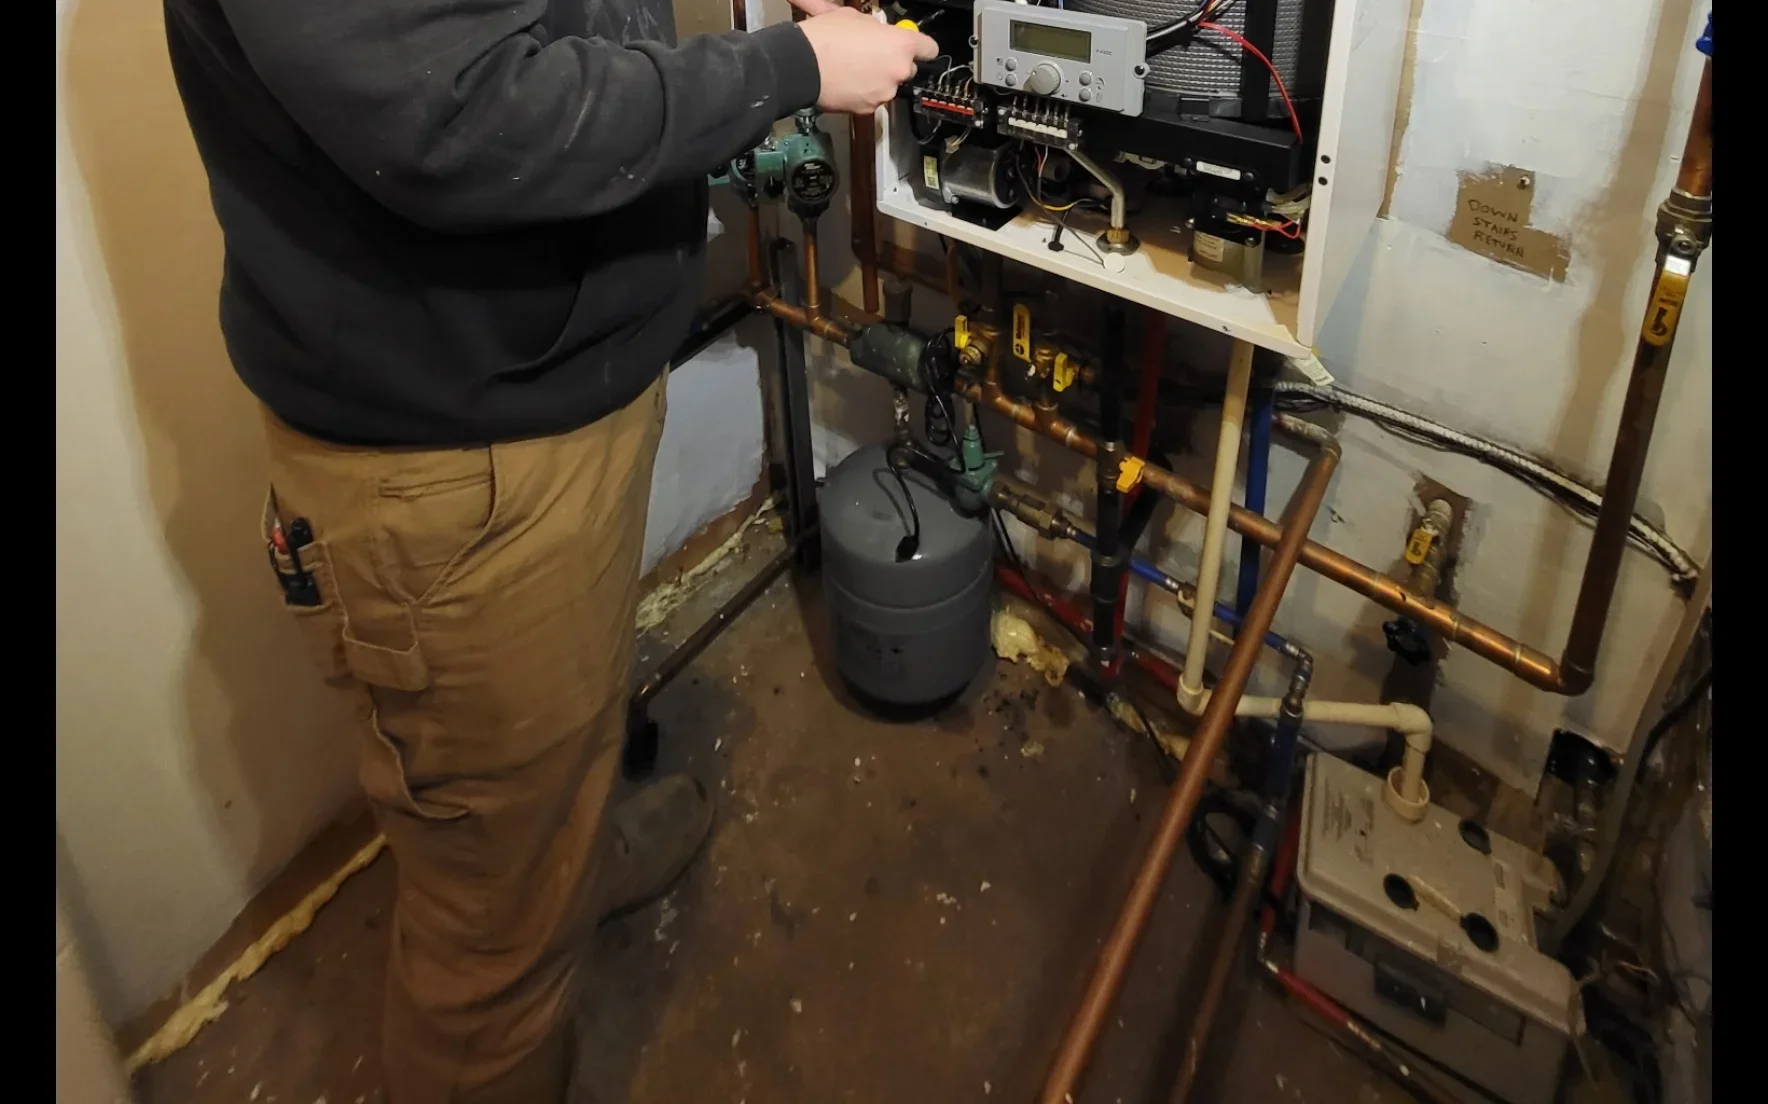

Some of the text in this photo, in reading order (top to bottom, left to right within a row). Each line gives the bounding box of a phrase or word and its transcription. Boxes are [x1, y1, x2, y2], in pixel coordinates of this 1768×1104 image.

[1468, 199, 1519, 223] DOWN
[1473, 216, 1519, 241] STAIRS
[1473, 230, 1525, 258] RETURN
